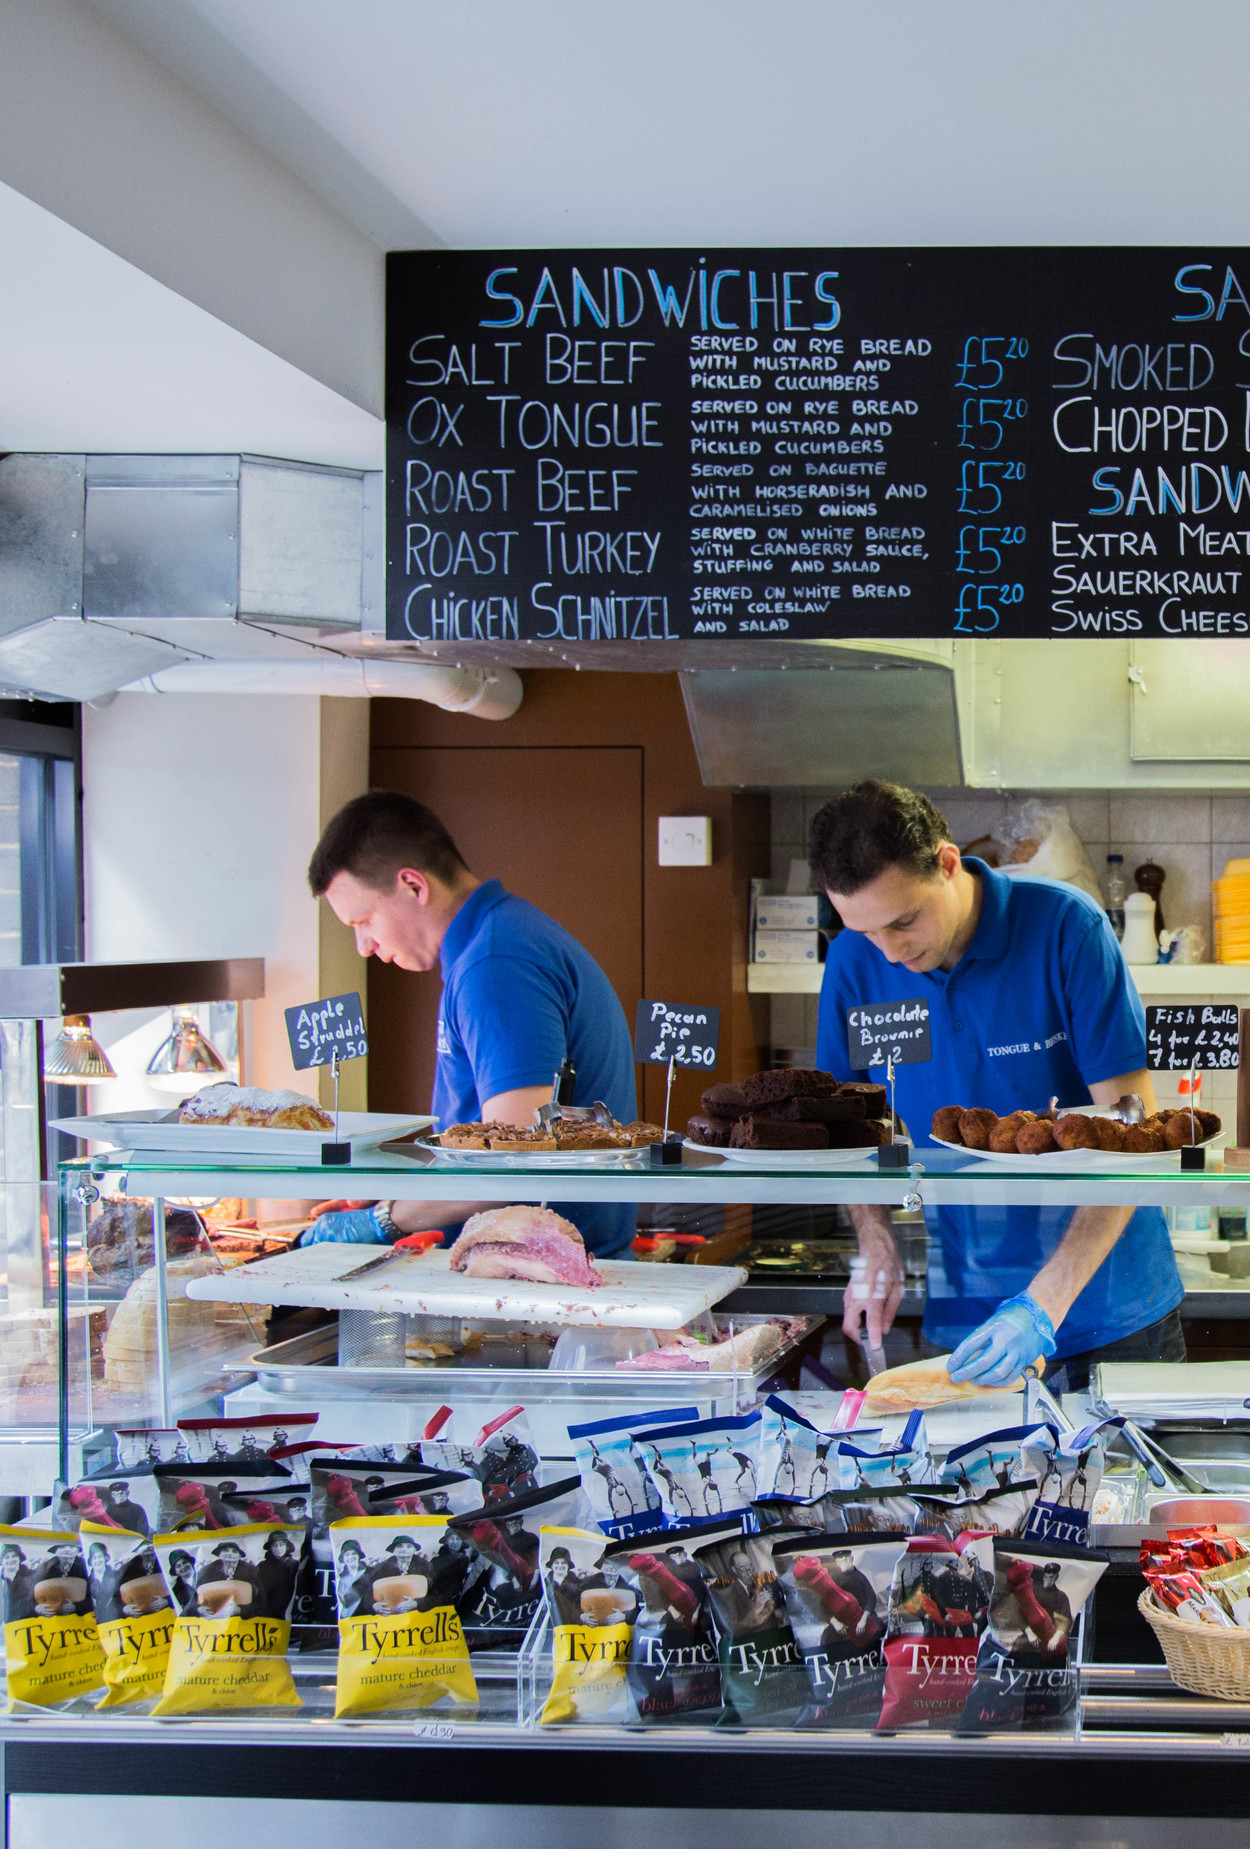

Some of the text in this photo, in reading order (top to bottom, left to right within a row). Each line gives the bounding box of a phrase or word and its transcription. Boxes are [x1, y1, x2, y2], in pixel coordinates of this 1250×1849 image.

[691, 335, 931, 356] SERVED ON RYE BREAD
[754, 356, 837, 370] MUSTARD
[853, 359, 890, 372] AND
[775, 375, 878, 391] CUCUMBERS
[691, 461, 887, 476] SERVED ON BAGUETTE
[885, 484, 927, 499] AND
[691, 527, 756, 544] SERVED
[767, 528, 787, 540] ON
[865, 526, 925, 540] BREAD
[791, 560, 824, 572] AND
[832, 561, 880, 573] SALAD
[747, 601, 830, 613] COLESLAW
[694, 618, 789, 633] AND SALAD
[297, 1000, 344, 1031] Apple
[651, 1002, 707, 1024] Pecan
[849, 1004, 929, 1027] Chocolate
[1155, 1006, 1238, 1024] Fish Balls
[660, 1022, 691, 1039] Pie
[1148, 1029, 1161, 1045] 4
[1168, 1030, 1189, 1049] for
[987, 1043, 1030, 1057] TONGUE
[1034, 1042, 1041, 1050] &
[1148, 1048, 1163, 1067] 7
[1168, 1051, 1188, 1070] for
[1026, 1504, 1088, 1544] Tyrre
[472, 1588, 540, 1627] Tyrre
[15, 1625, 99, 1666] Tyrre
[108, 1623, 174, 1666] Tyrr
[29, 1660, 106, 1687] mature ched
[360, 1663, 457, 1685] mature cheddar
[804, 1648, 882, 1698] Tyrre
[902, 1644, 977, 1689] Tyrre
[223, 1672, 270, 1686] cheddar
